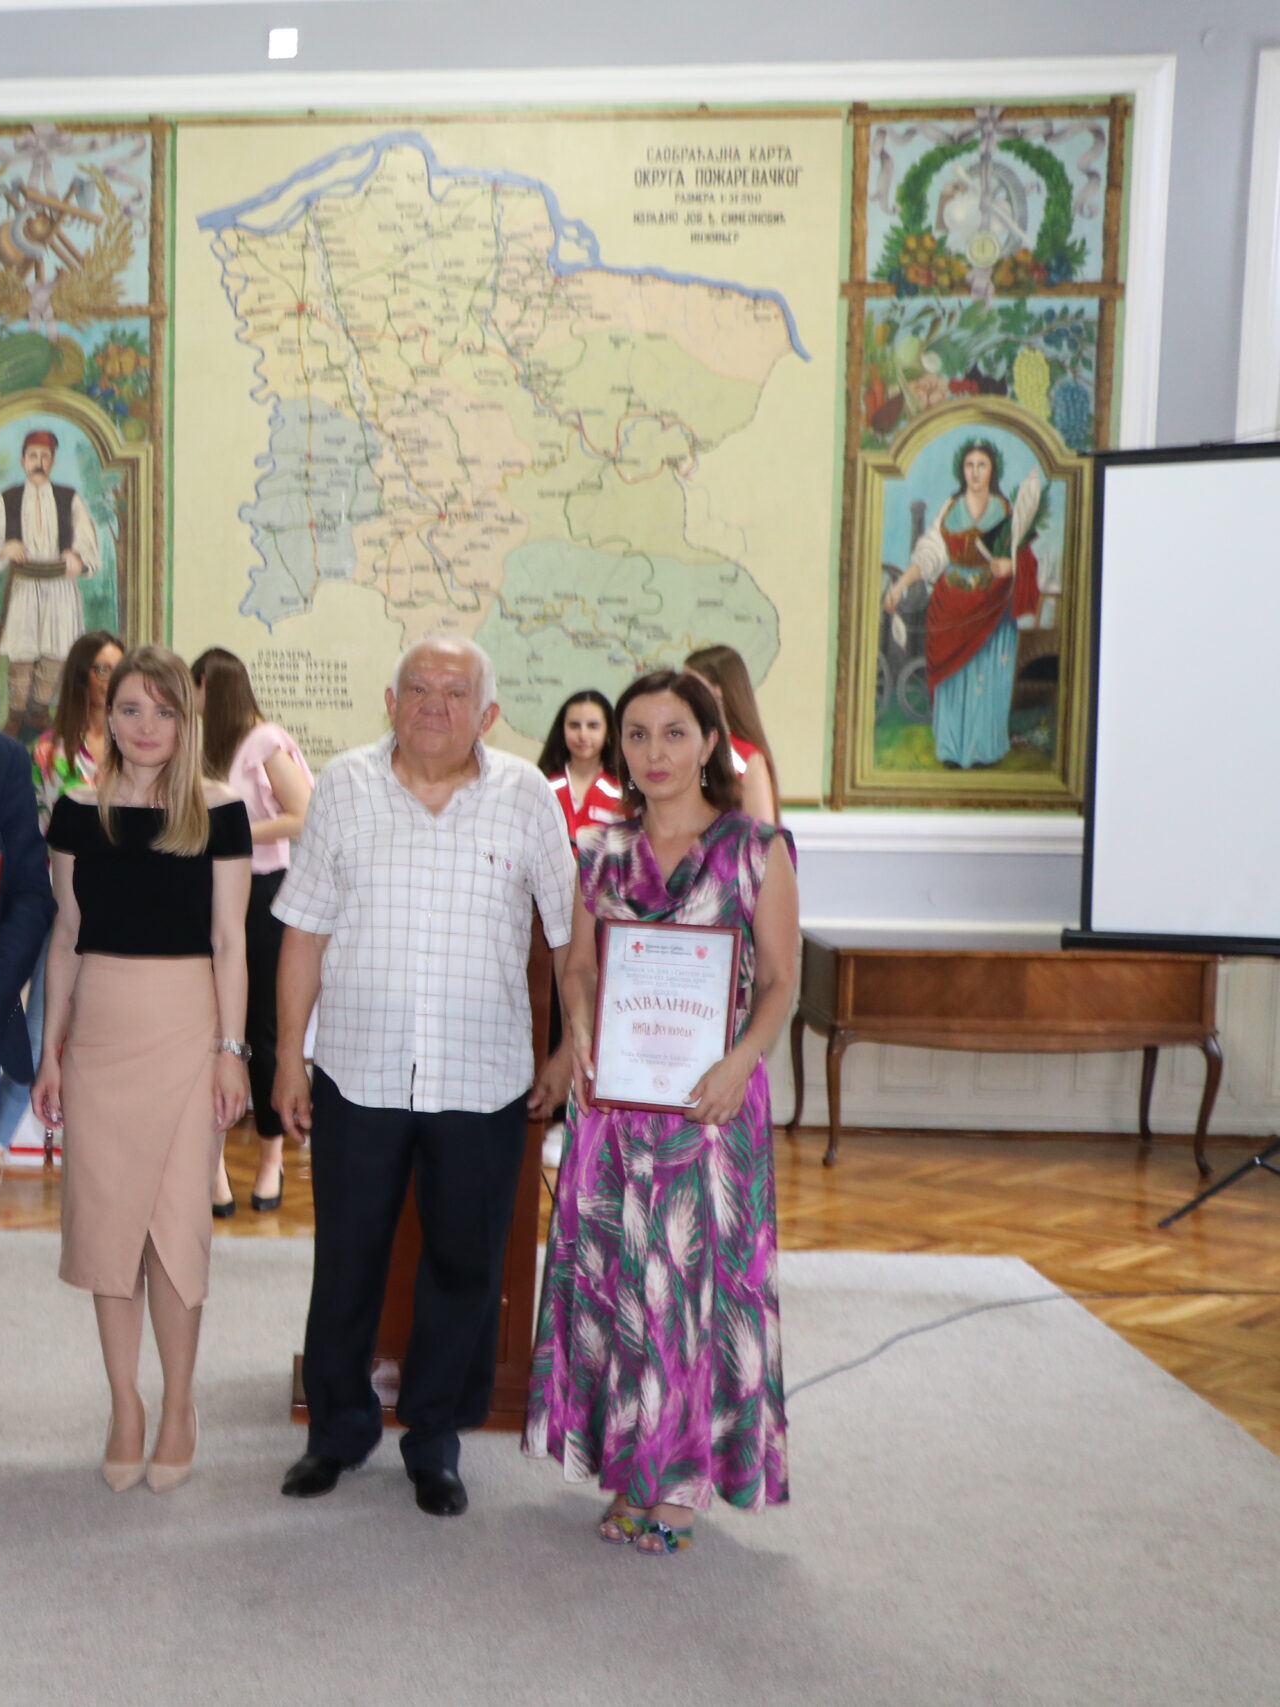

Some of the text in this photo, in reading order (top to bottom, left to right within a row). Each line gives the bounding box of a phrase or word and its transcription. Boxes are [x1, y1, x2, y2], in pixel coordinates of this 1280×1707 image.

[749, 145, 792, 162] КАРТА
[634, 166, 803, 187] ОКРУГА ПОЖАРЕВАЧКОГ
